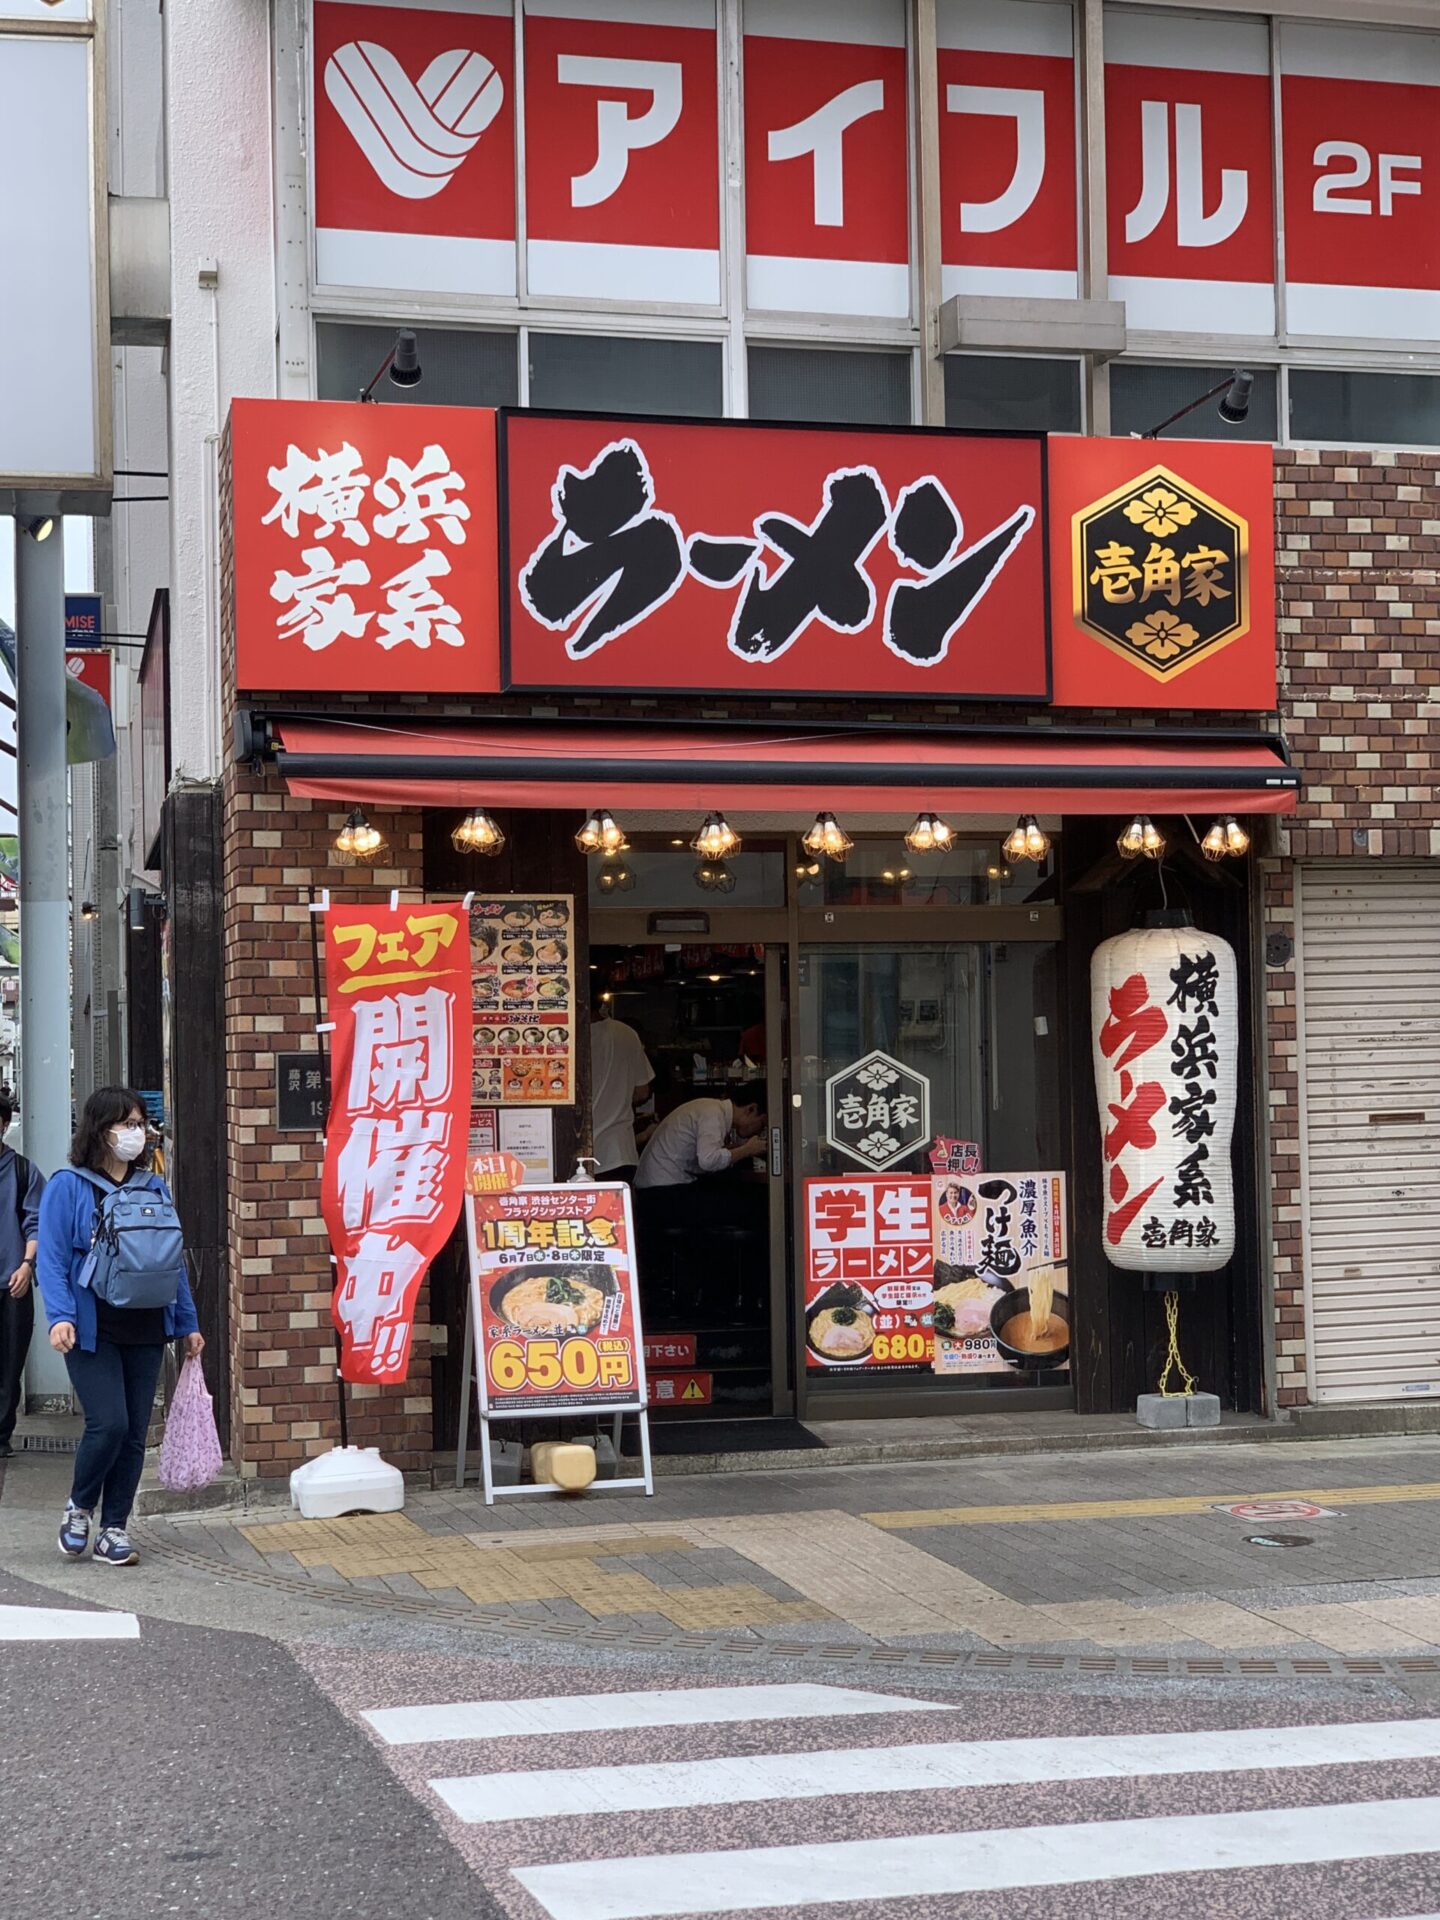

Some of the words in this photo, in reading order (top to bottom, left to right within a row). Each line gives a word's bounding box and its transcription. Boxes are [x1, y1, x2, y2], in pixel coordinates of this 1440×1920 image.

[557, 54, 1248, 248] アイフル
[1312, 139, 1423, 217] 2F
[261, 441, 471, 546] 横浜
[518, 437, 1036, 667] ラーメン
[1088, 542, 1233, 607] 壱角家
[268, 545, 467, 651] 家系
[332, 912, 460, 973] フェア
[1167, 951, 1220, 1209] 横浜家系
[836, 1093, 920, 1130] 壱角家
[1099, 971, 1169, 1246] ラーメン
[473, 1156, 506, 1174] 本日
[933, 1158, 979, 1172] 一押し!
[951, 1144, 977, 1157] 店長
[473, 1173, 510, 1191] 開催
[531, 1194, 596, 1206] 渋谷センター街
[482, 1217, 617, 1250] 1周年記念
[504, 1206, 593, 1217] フラッグシップストア
[814, 1185, 932, 1246] 学生
[977, 1179, 1021, 1276] つけ麺
[1019, 1180, 1039, 1257] 濃厚魚介
[1141, 1215, 1221, 1249] 壱角家
[814, 1248, 932, 1278] ラーメン
[488, 1325, 549, 1337] 家系ラーメン
[872, 1314, 900, 1329] (並)
[490, 1339, 631, 1390] 650円
